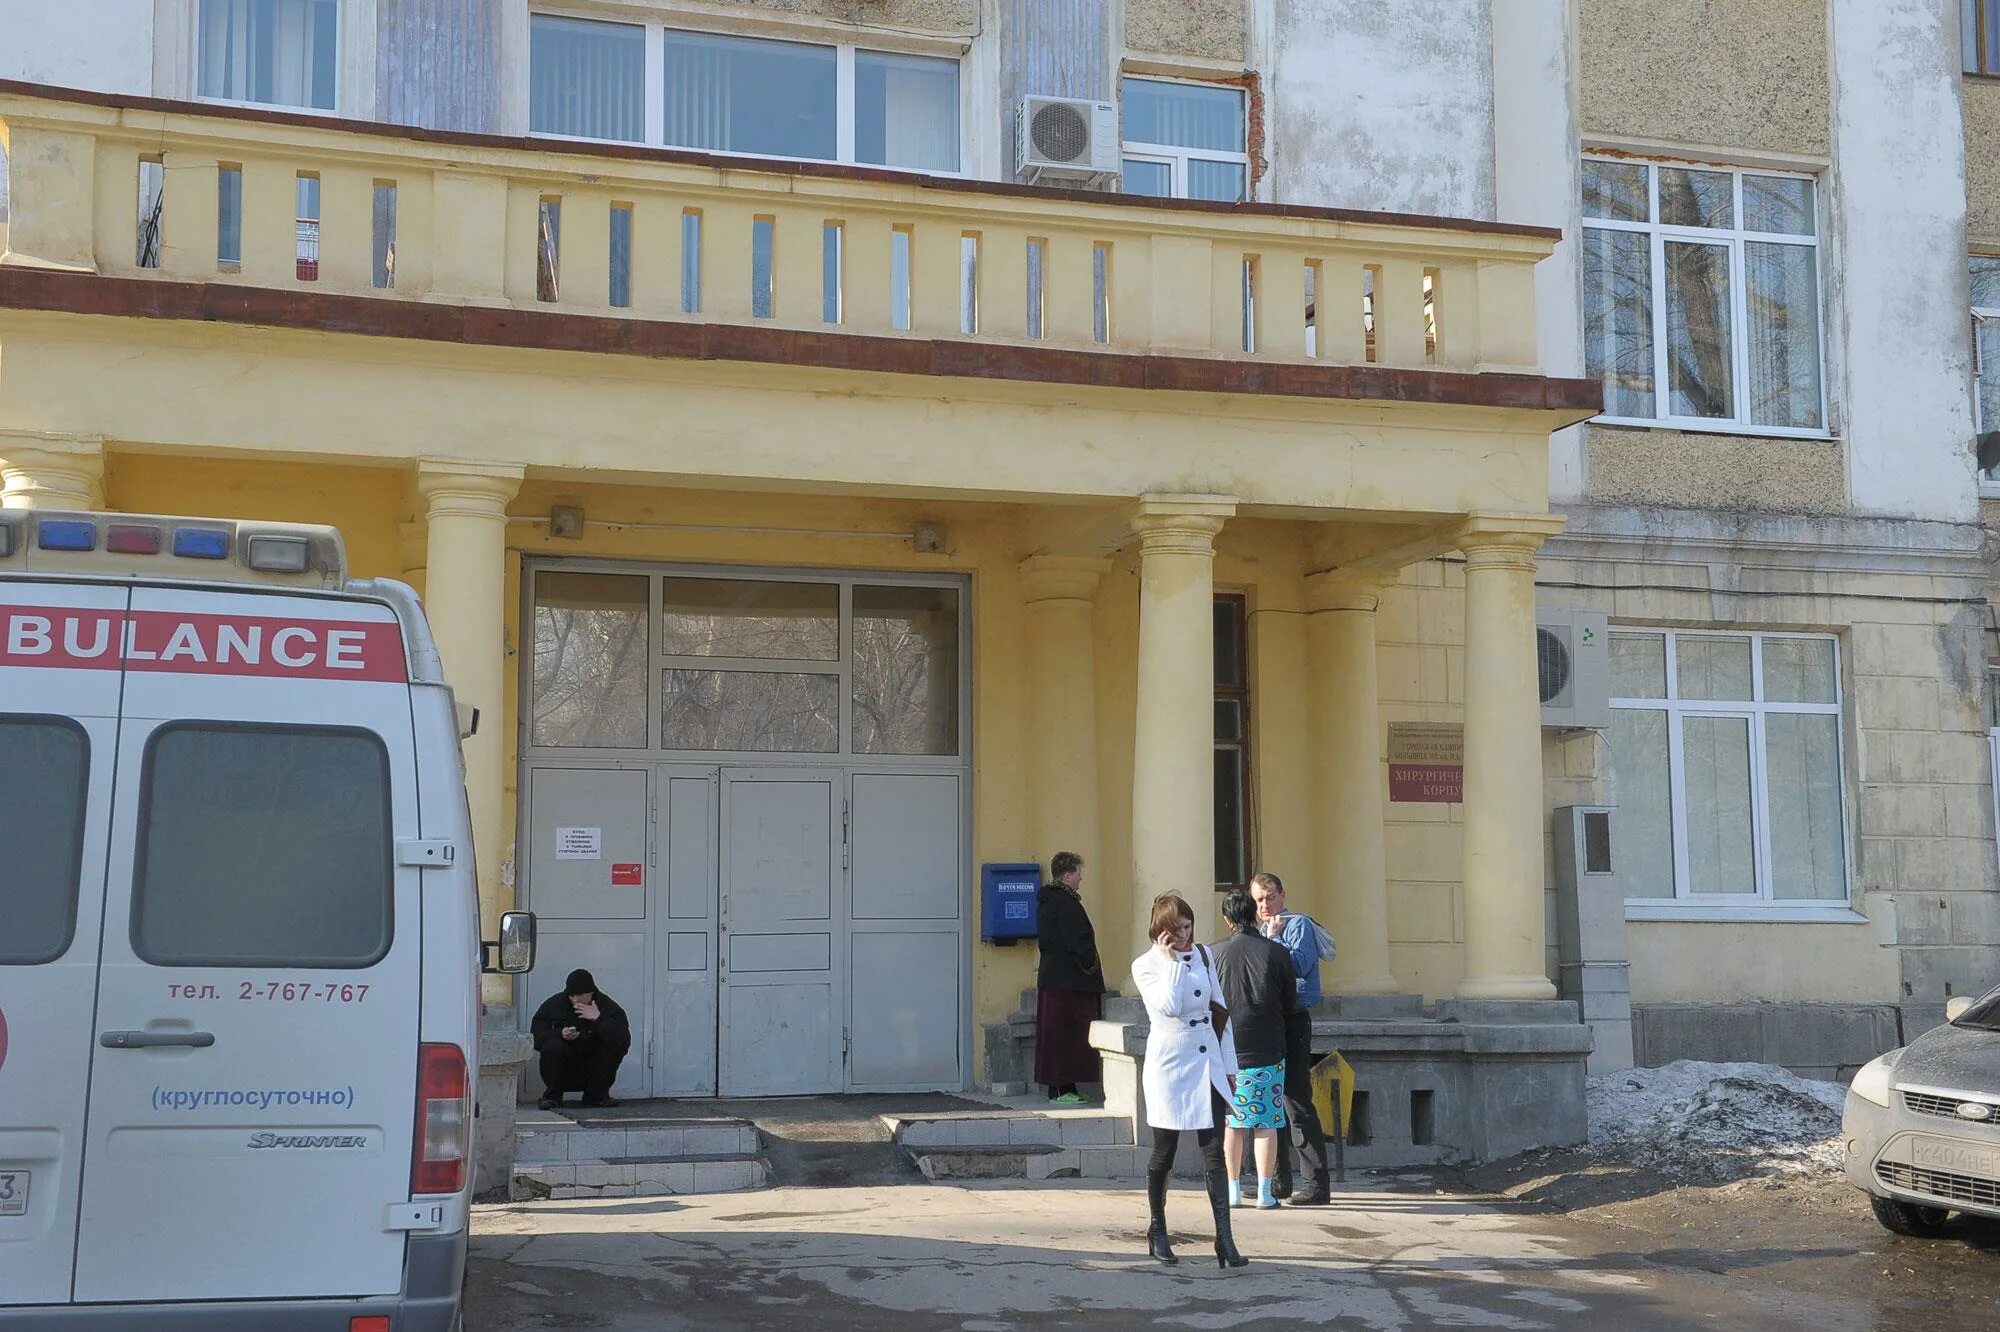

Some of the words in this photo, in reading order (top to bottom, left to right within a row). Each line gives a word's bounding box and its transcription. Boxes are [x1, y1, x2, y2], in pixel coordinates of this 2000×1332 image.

[7, 615, 366, 669] BULANCE
[168, 984, 220, 999] тел.
[239, 982, 369, 1002] 2-767-767
[152, 1086, 354, 1110] (круглосуточно)
